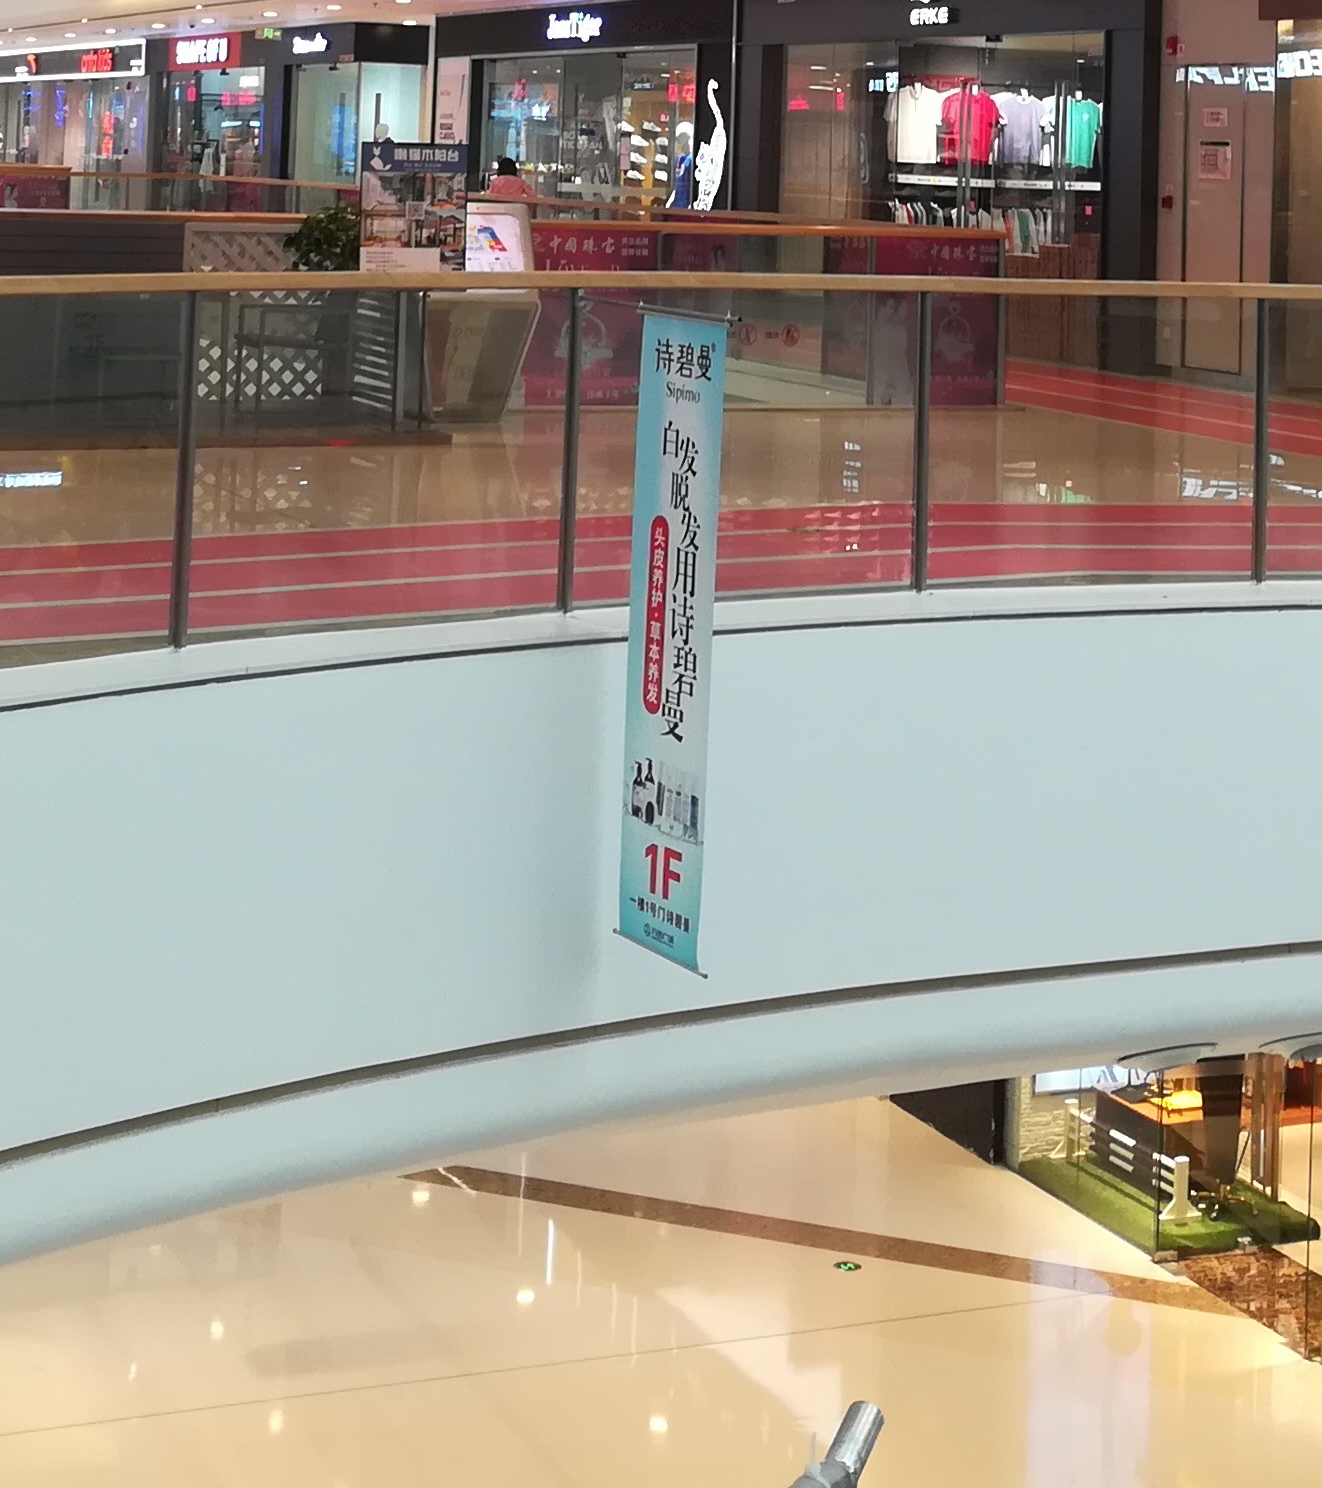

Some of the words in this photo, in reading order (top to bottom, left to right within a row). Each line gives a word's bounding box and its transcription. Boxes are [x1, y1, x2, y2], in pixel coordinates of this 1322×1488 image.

[655, 338, 712, 382] 诗碧曼
[666, 381, 701, 404] Sipimo
[660, 420, 701, 744] 白发脱发用诗碧曼
[644, 843, 683, 901] 1F
